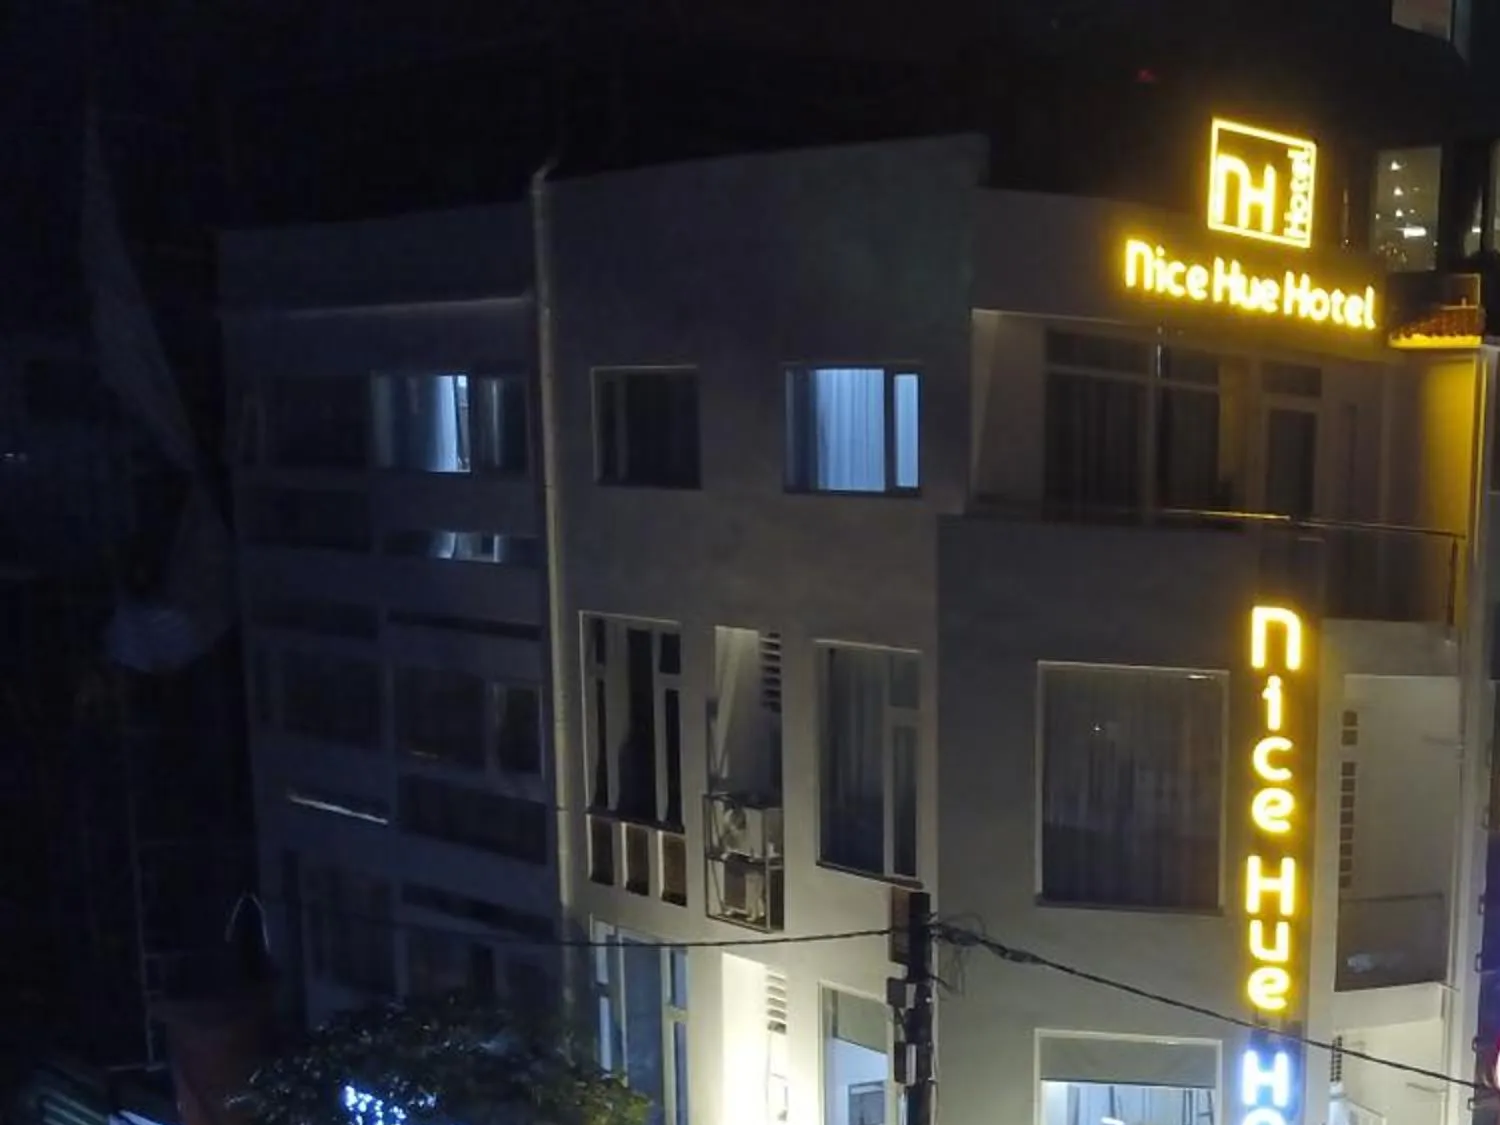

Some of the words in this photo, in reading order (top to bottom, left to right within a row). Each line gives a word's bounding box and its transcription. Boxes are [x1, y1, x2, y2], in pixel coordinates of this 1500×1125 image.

[1213, 256, 1280, 313] Hue
[1283, 270, 1376, 330] Hotel
[1245, 855, 1297, 1012] Hue
